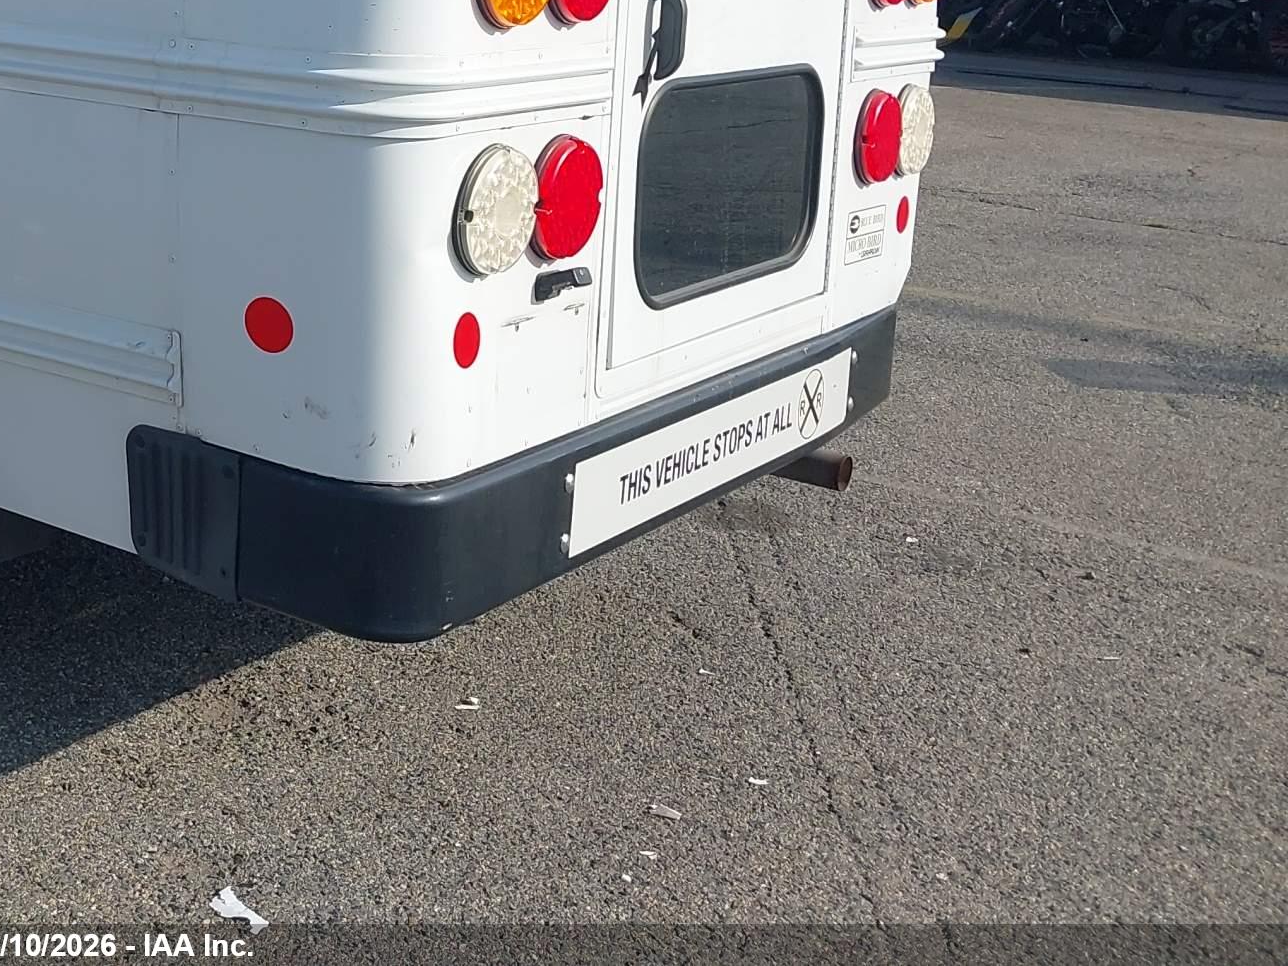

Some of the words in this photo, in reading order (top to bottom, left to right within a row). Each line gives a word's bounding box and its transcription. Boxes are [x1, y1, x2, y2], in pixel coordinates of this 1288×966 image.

[867, 233, 881, 248] BIRD
[620, 464, 652, 505] THIS
[656, 438, 711, 488] VEHICLE
[713, 419, 753, 462] STOPS
[754, 412, 771, 443] AT
[772, 402, 793, 435] ALL
